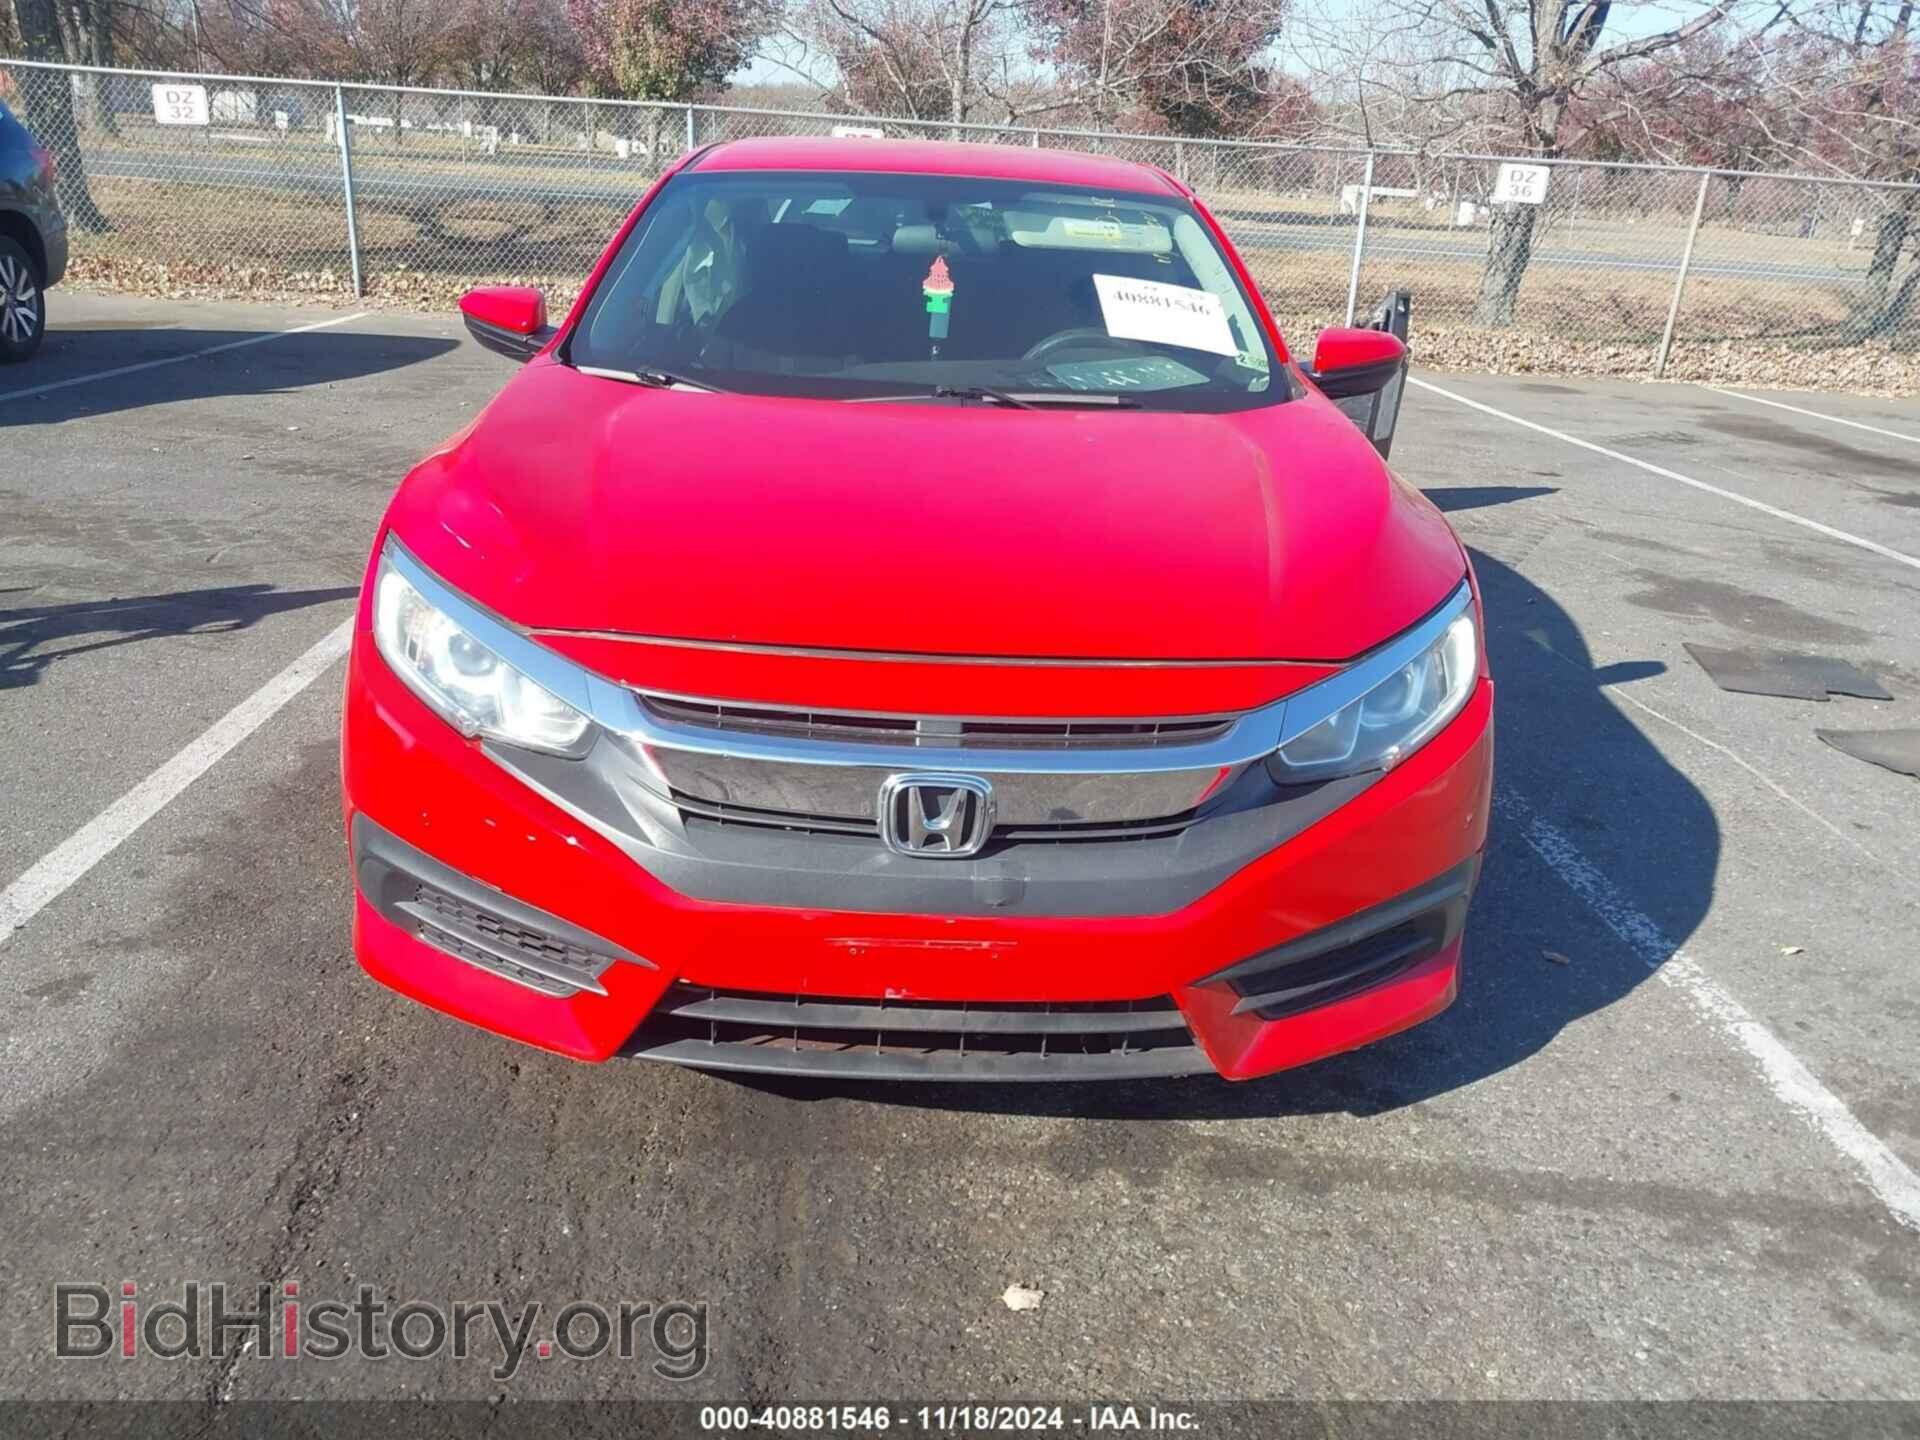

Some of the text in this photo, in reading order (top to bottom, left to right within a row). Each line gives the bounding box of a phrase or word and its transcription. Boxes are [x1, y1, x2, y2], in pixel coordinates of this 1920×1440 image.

[166, 90, 194, 104] DZ
[169, 105, 193, 119] 32
[1510, 169, 1537, 184] DZ
[1509, 184, 1532, 197] 36
